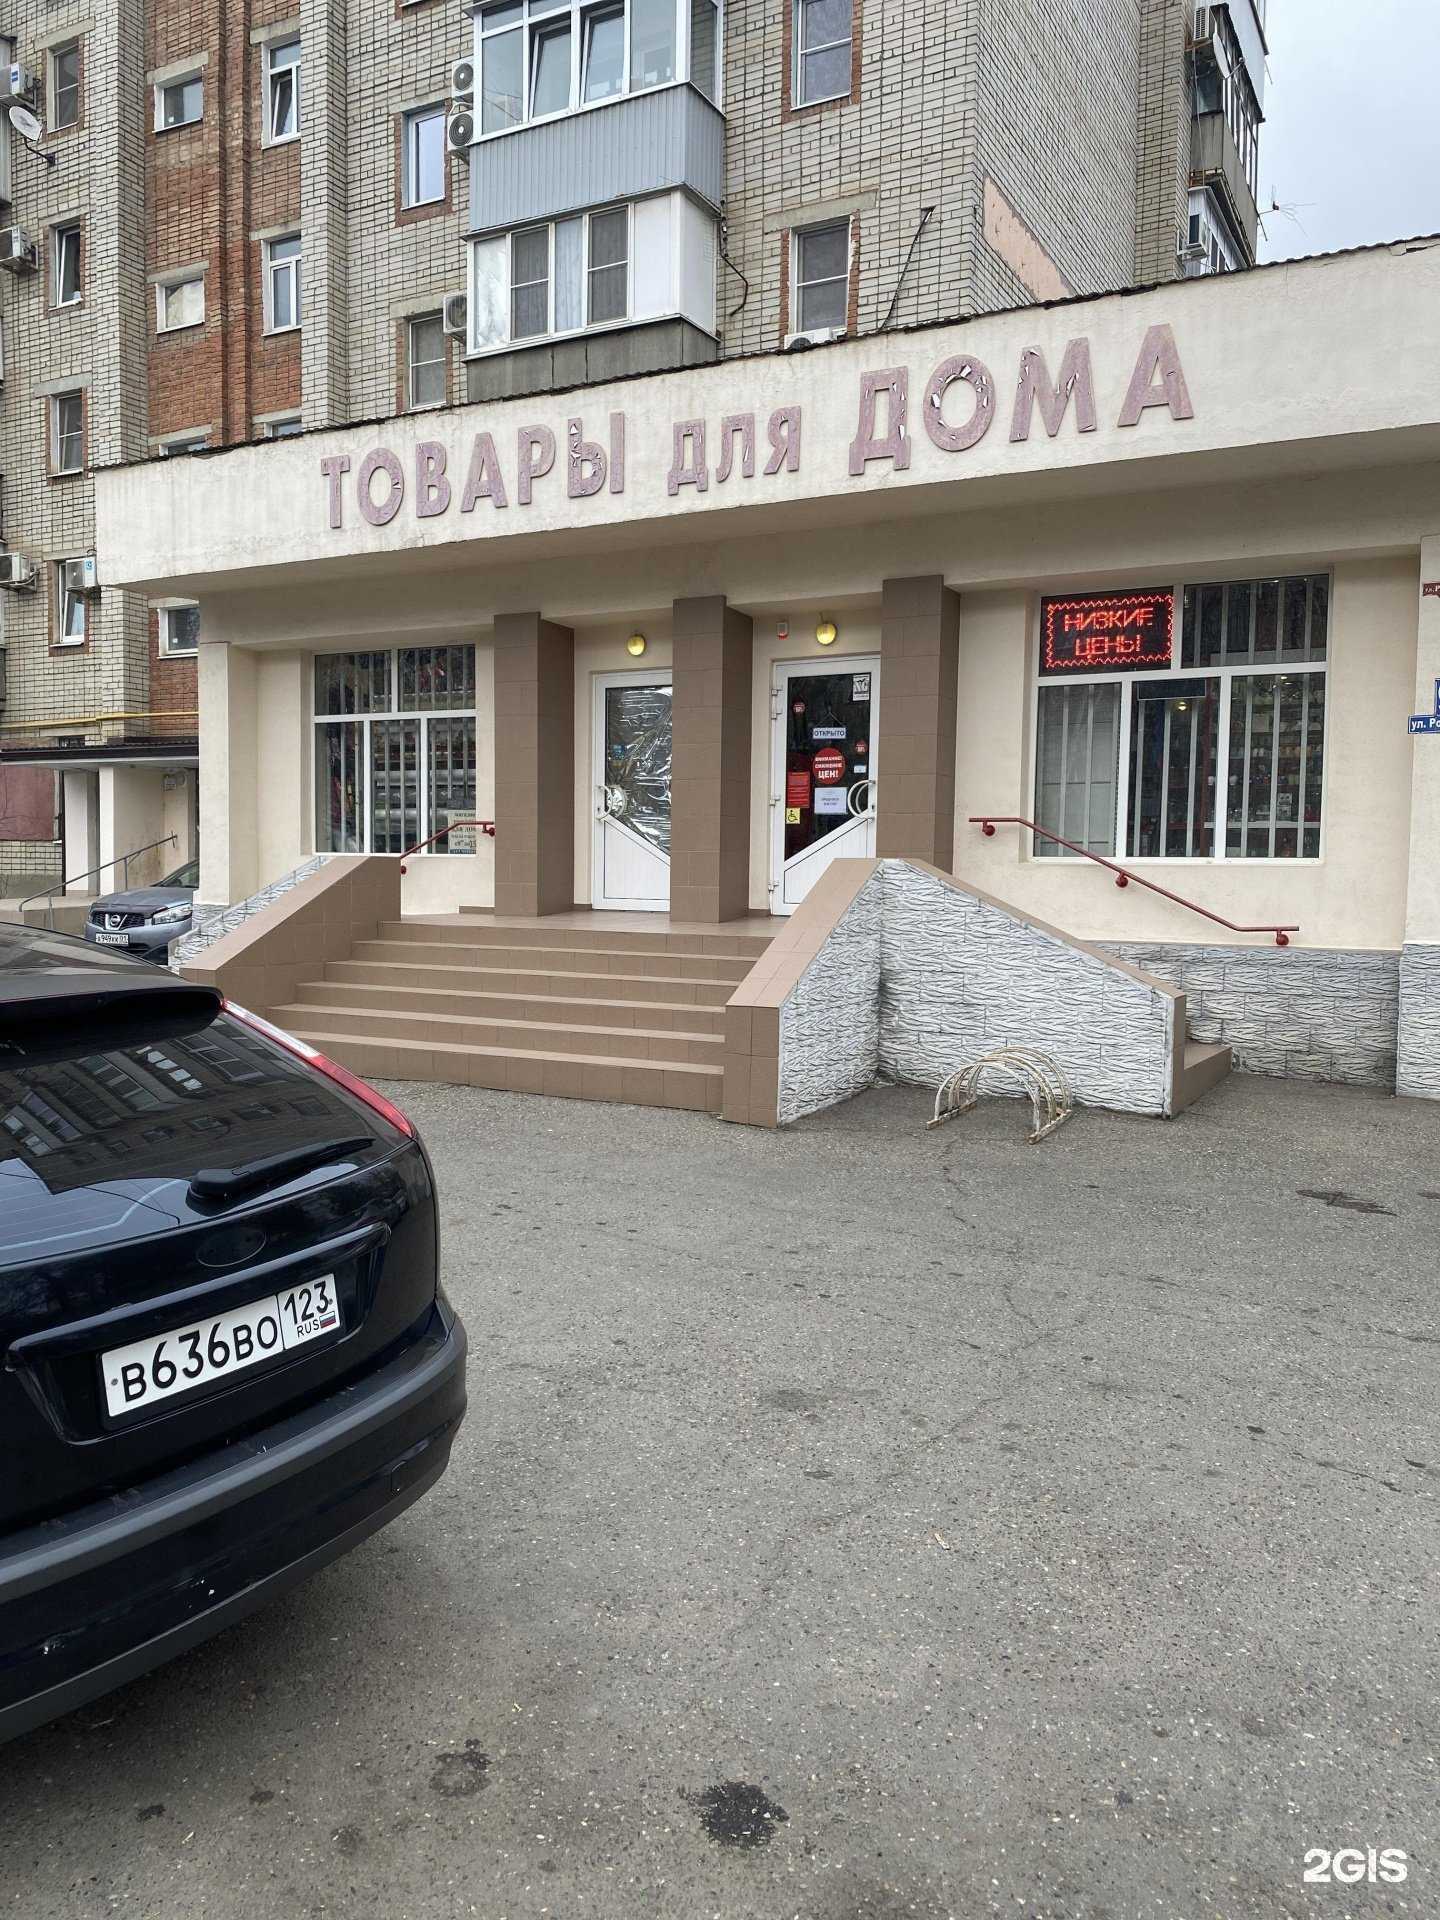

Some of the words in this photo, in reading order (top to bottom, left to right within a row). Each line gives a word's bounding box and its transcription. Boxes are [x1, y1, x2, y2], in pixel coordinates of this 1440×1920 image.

[320, 411, 625, 529] ТОВАРЫ
[667, 405, 801, 496] ДЛЯ
[848, 322, 1194, 476] ДОМА
[1064, 607, 1153, 632] НИЗКИЕ
[1075, 634, 1141, 660] ЦЕНЫ
[1411, 720, 1426, 731] ул.
[818, 770, 839, 779] ЦЕН!
[297, 1318, 320, 1338] RUS
[121, 1316, 278, 1402] В636ВО
[284, 1281, 329, 1325] 123
